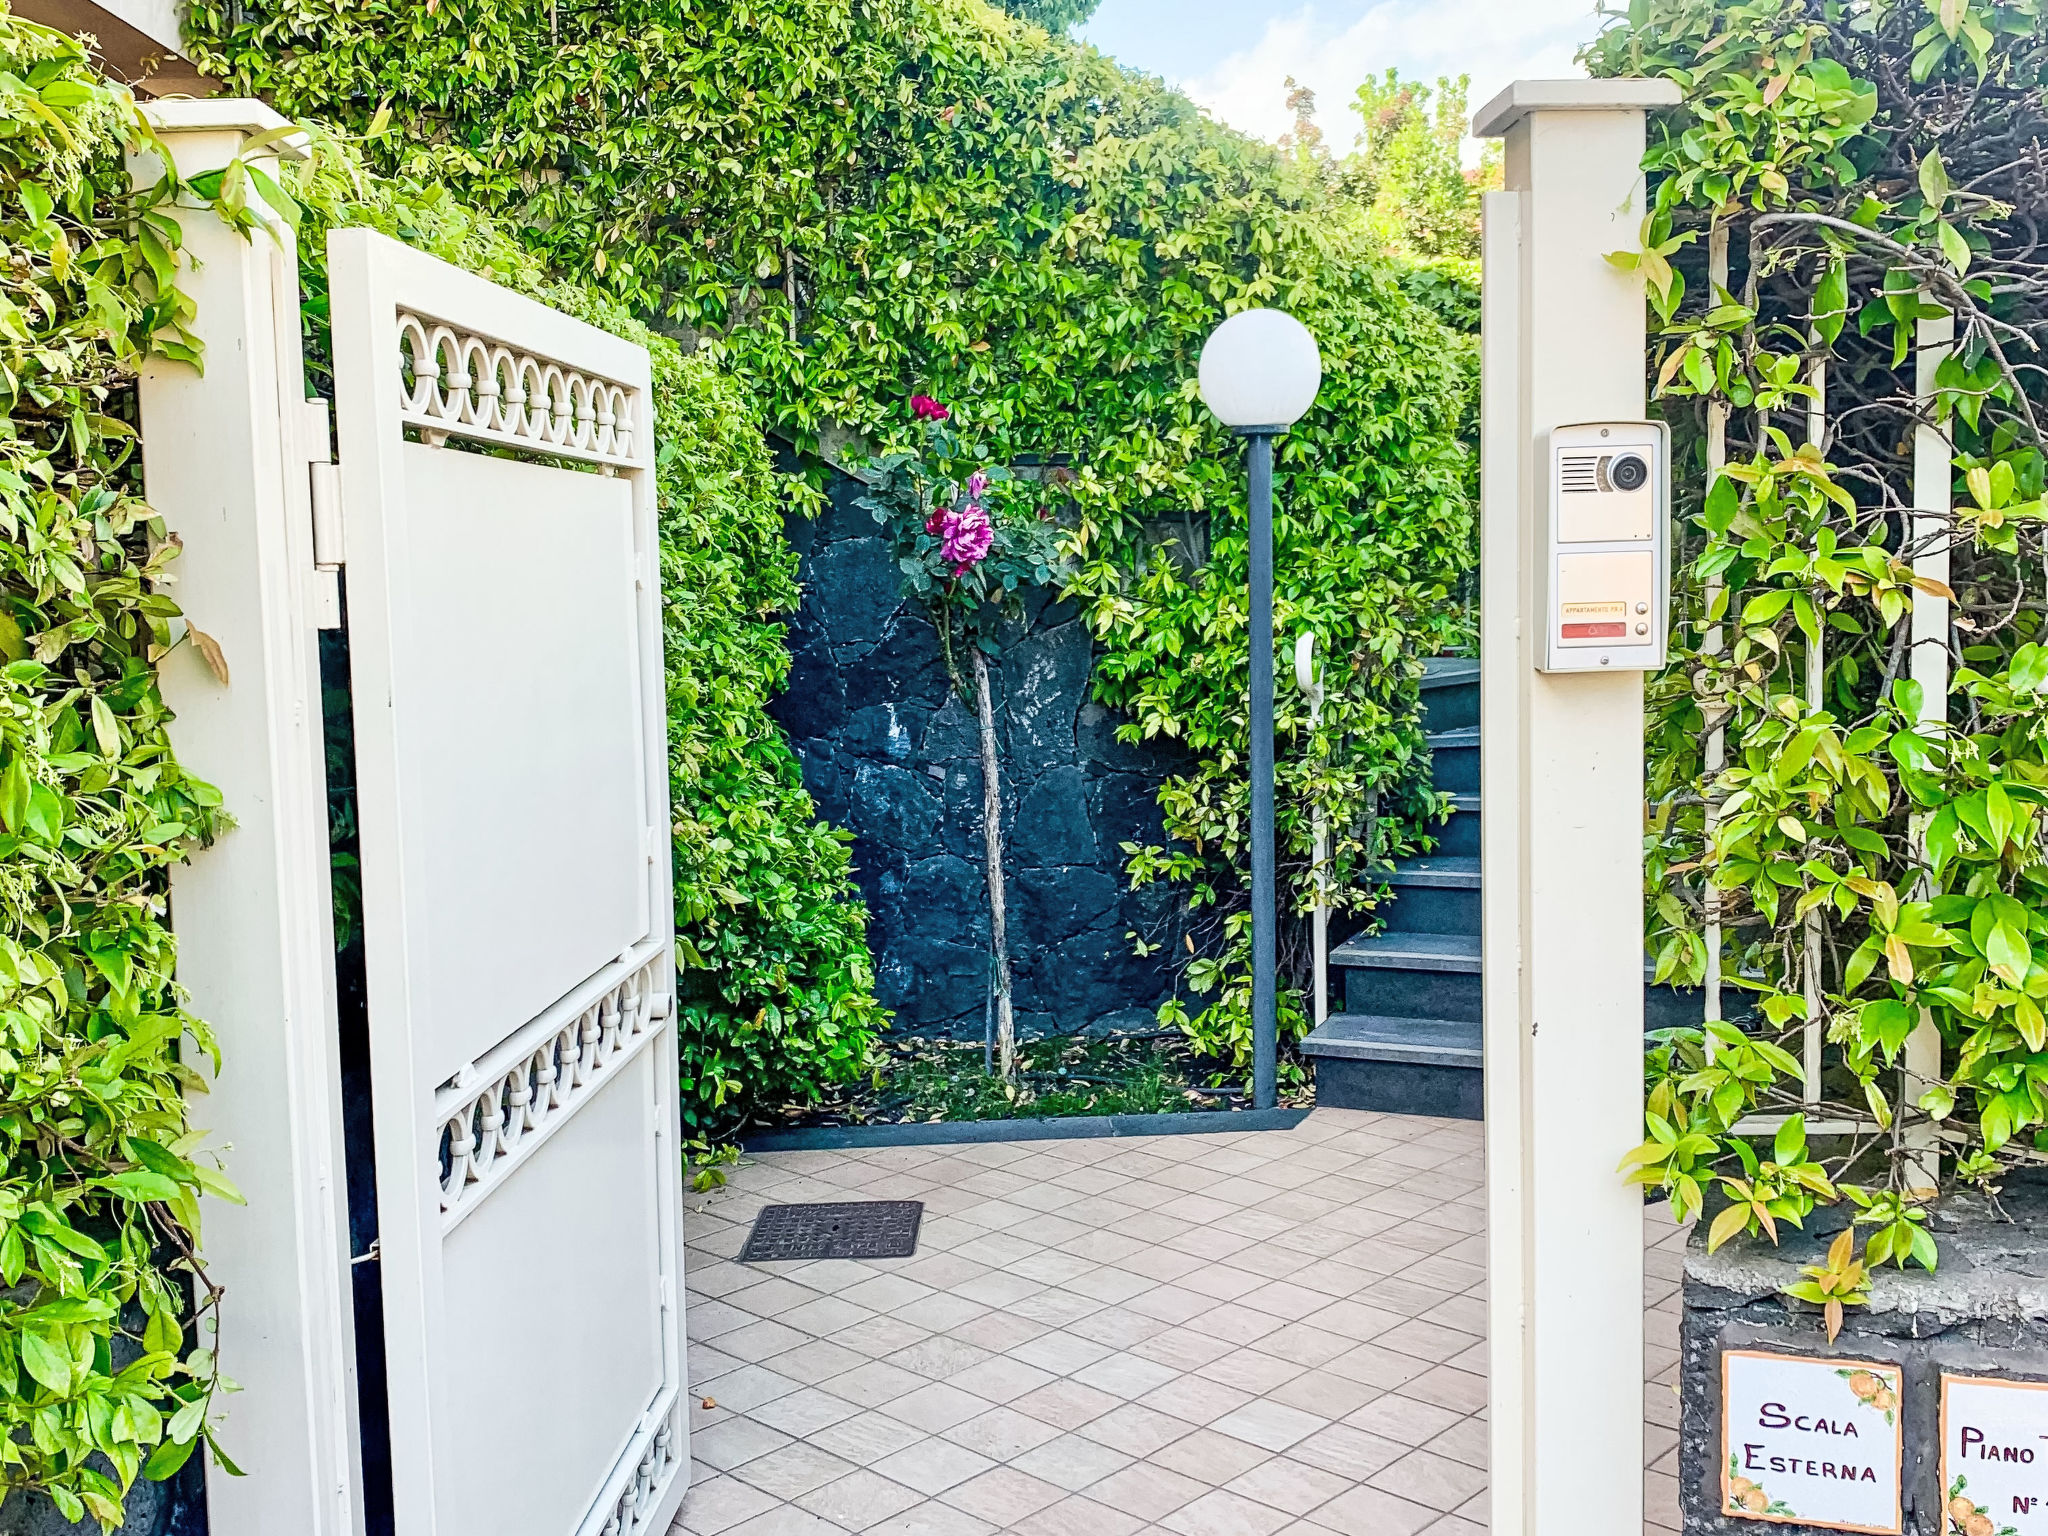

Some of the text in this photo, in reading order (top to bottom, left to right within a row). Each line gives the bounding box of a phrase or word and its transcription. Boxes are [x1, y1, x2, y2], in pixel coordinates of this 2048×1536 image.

[1759, 1402, 1859, 1438] SCALA
[1744, 1443, 1877, 1483] ESTERNA
[1961, 1426, 2035, 1464] PIANO
